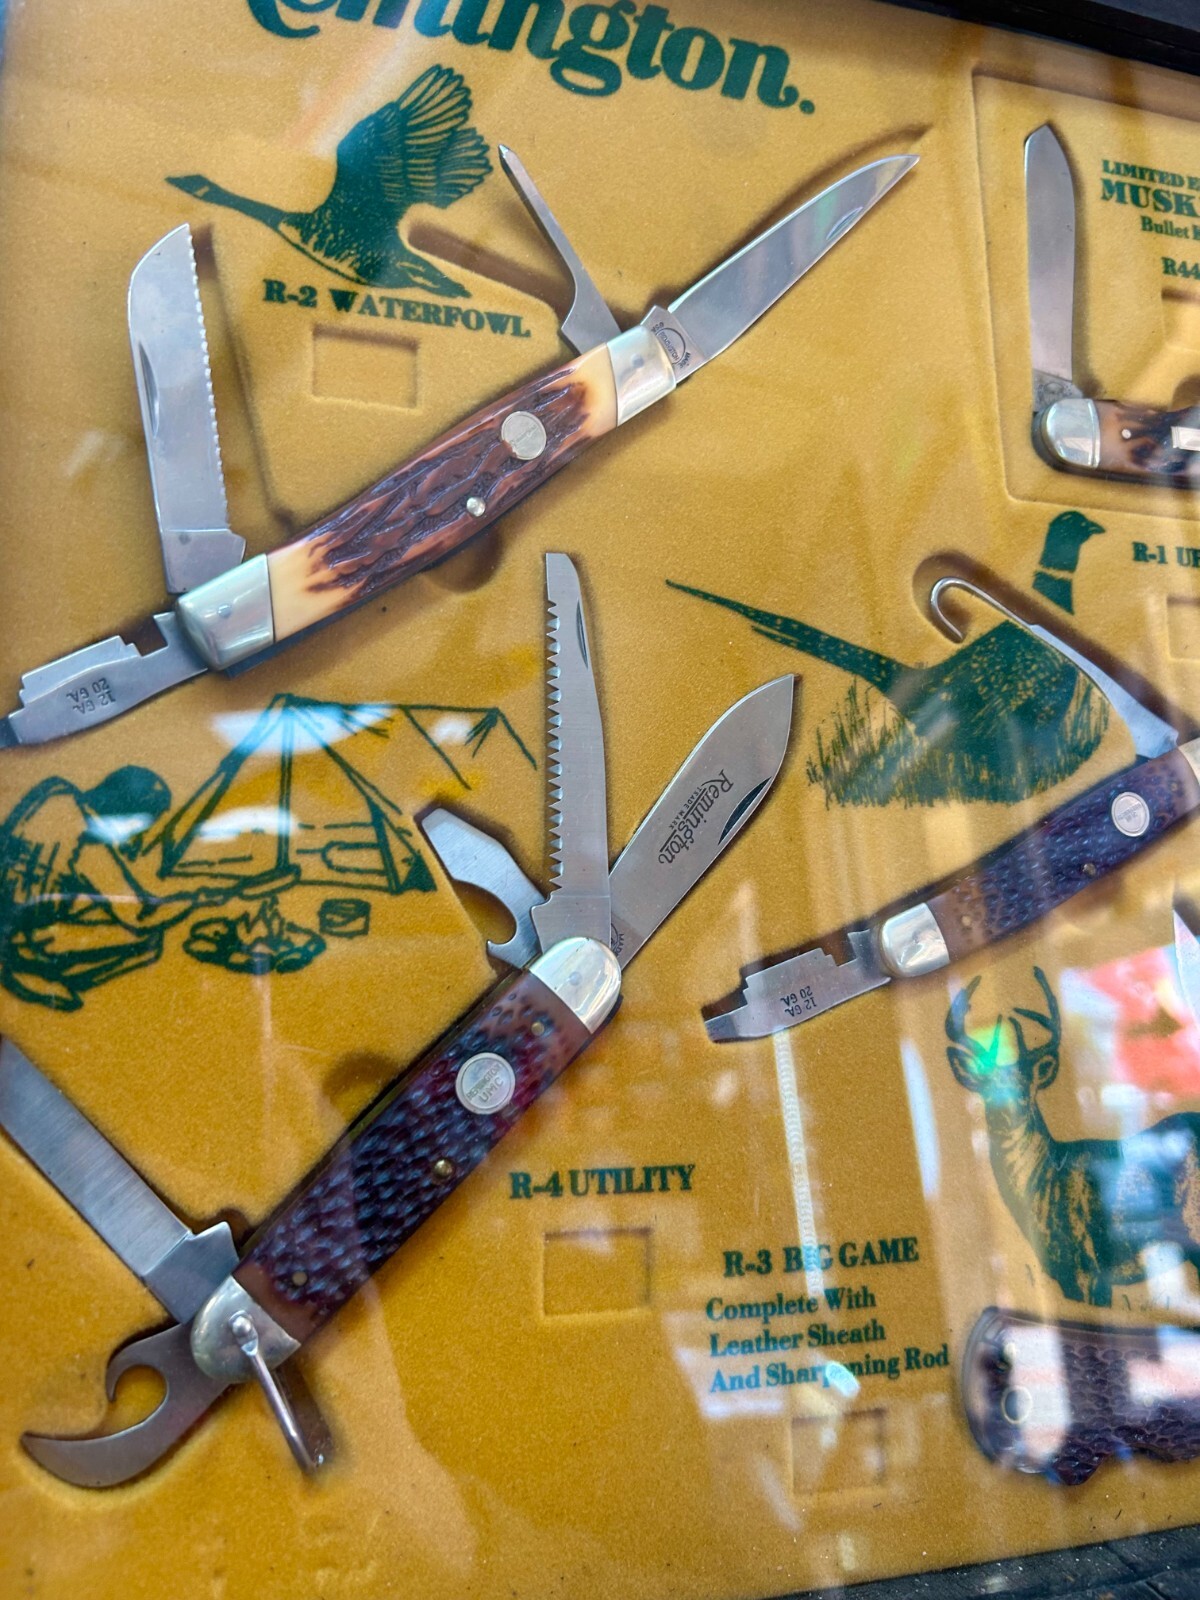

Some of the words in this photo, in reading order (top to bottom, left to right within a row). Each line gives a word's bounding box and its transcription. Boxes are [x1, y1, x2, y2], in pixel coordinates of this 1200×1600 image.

[1101, 159, 1185, 188] LIMITED
[1140, 215, 1190, 239] Bullet
[262, 278, 318, 308] R-2
[329, 288, 531, 338] WATERFOWL
[1132, 541, 1168, 565] R-1
[658, 769, 734, 864] Remington
[800, 986, 813, 999] 20
[806, 998, 818, 1010] 12
[479, 1077, 503, 1102] UMC
[509, 1170, 564, 1199] R-4
[568, 1164, 695, 1196] UTILITY
[723, 1249, 773, 1277] R-3
[783, 1244, 833, 1273] BIG
[838, 1237, 919, 1268] GAME
[706, 1292, 819, 1324] Complete
[823, 1286, 877, 1311] With
[709, 1328, 804, 1357] Leather
[807, 1318, 886, 1348] Sheath
[710, 1363, 761, 1393] And
[766, 1353, 900, 1389] Sharpning
[904, 1343, 950, 1371] Rod
